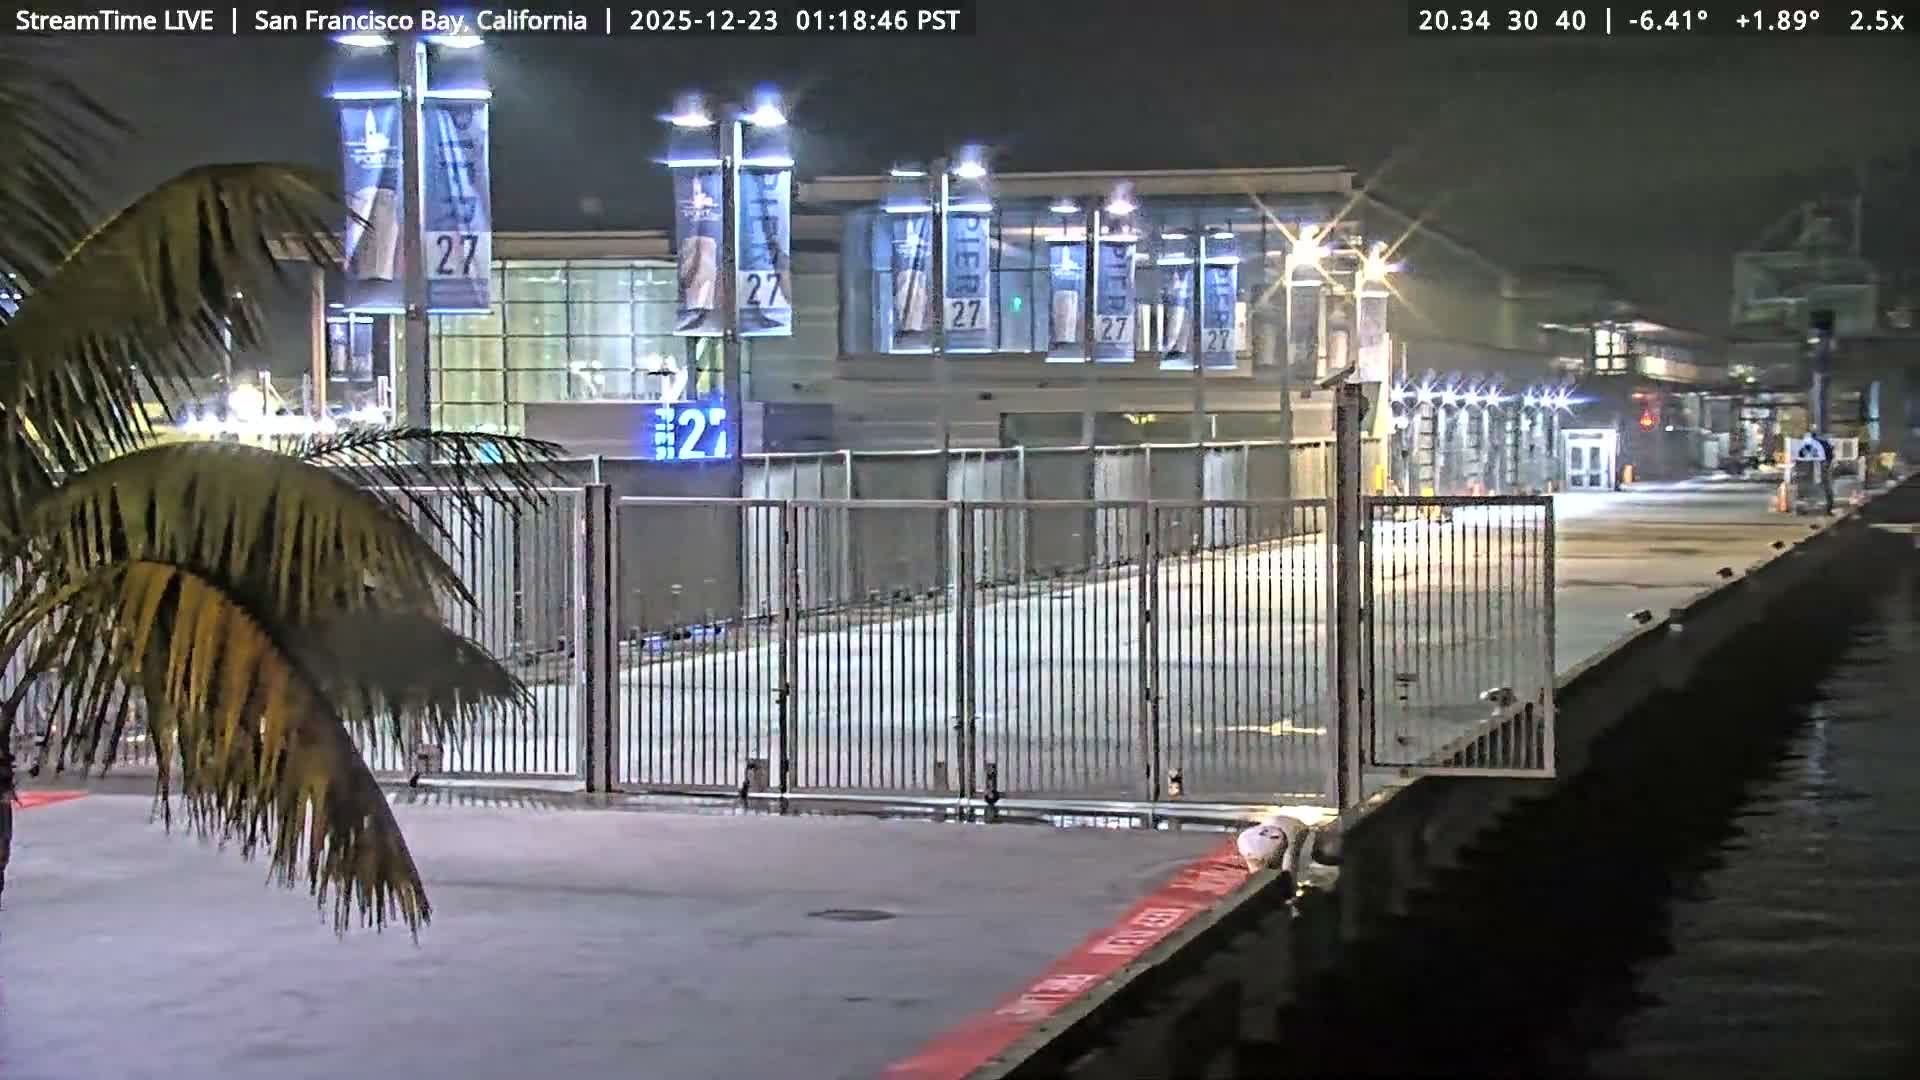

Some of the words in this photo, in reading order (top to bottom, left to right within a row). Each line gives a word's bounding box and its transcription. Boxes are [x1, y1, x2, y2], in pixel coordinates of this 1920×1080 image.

[437, 235, 479, 275] 27
[955, 215, 979, 294] PIER
[747, 273, 781, 306] 27
[1104, 244, 1127, 311] PIER
[953, 300, 980, 328] 27
[1101, 317, 1128, 341] 27
[1207, 329, 1230, 351] 27
